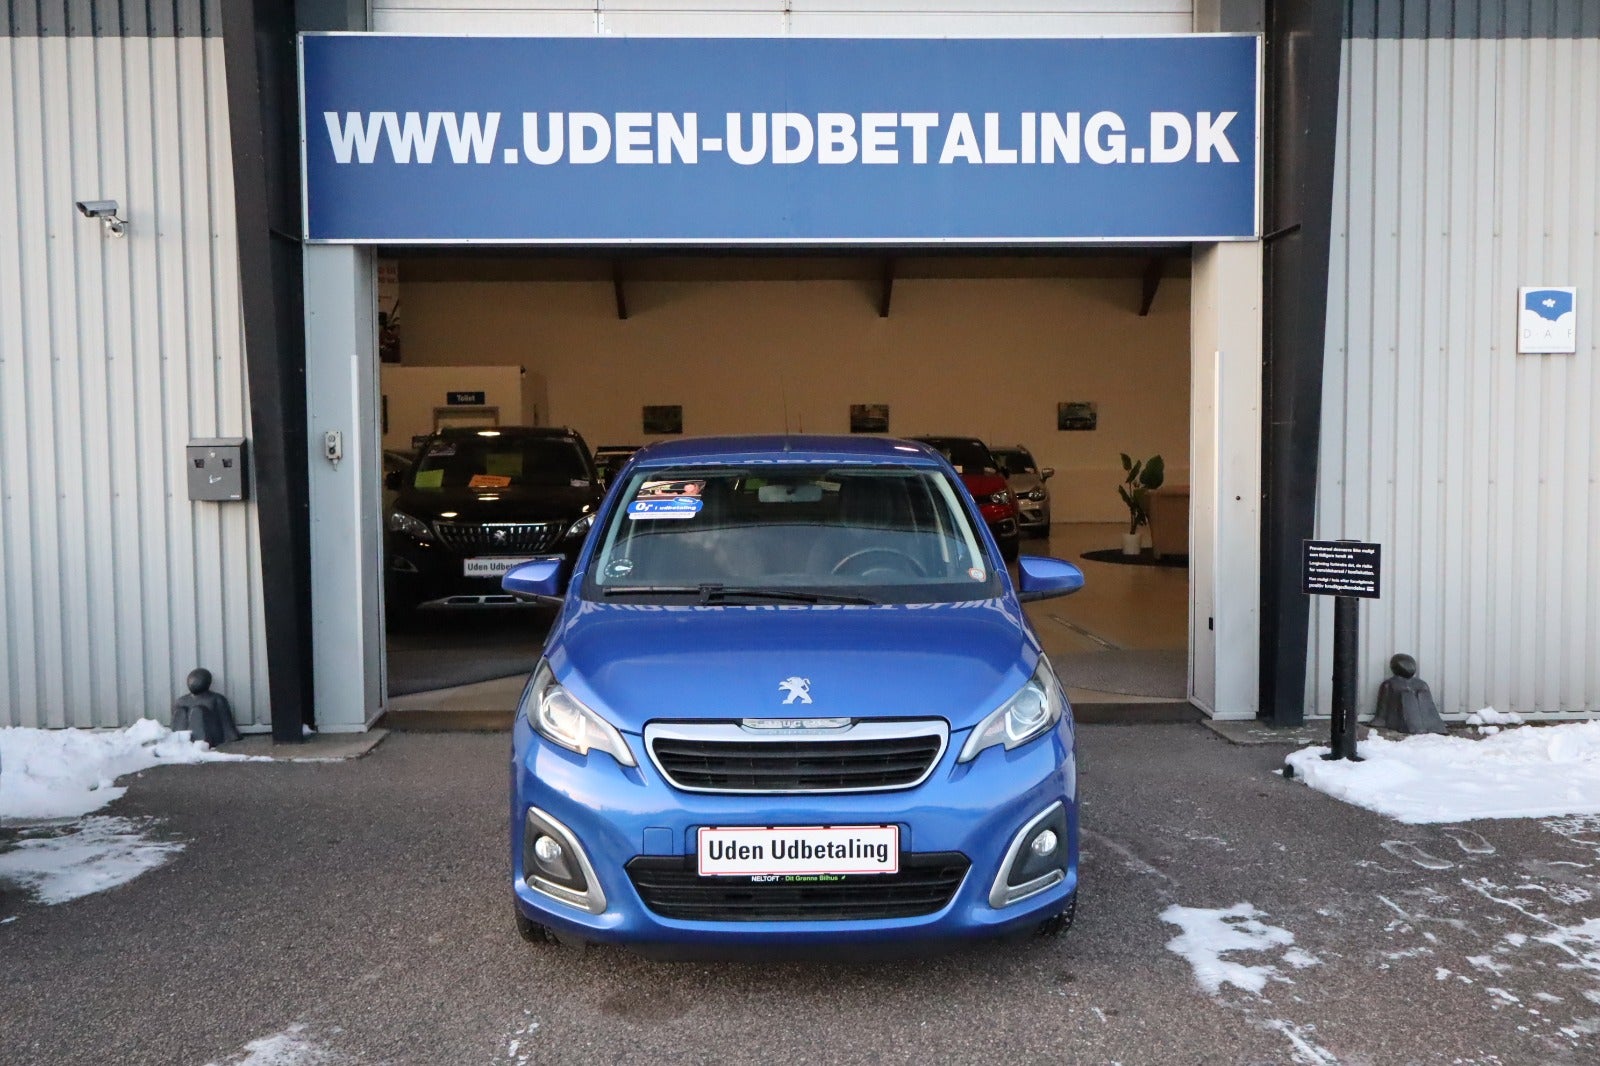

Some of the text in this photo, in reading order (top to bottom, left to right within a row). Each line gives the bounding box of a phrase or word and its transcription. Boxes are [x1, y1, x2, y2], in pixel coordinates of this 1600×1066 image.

[323, 110, 1240, 165] WWW.UDEN-UDBETALING.DK
[456, 394, 476, 402] Toilet
[467, 562, 488, 571] Uden
[709, 838, 888, 863] Uden Udbetaling
